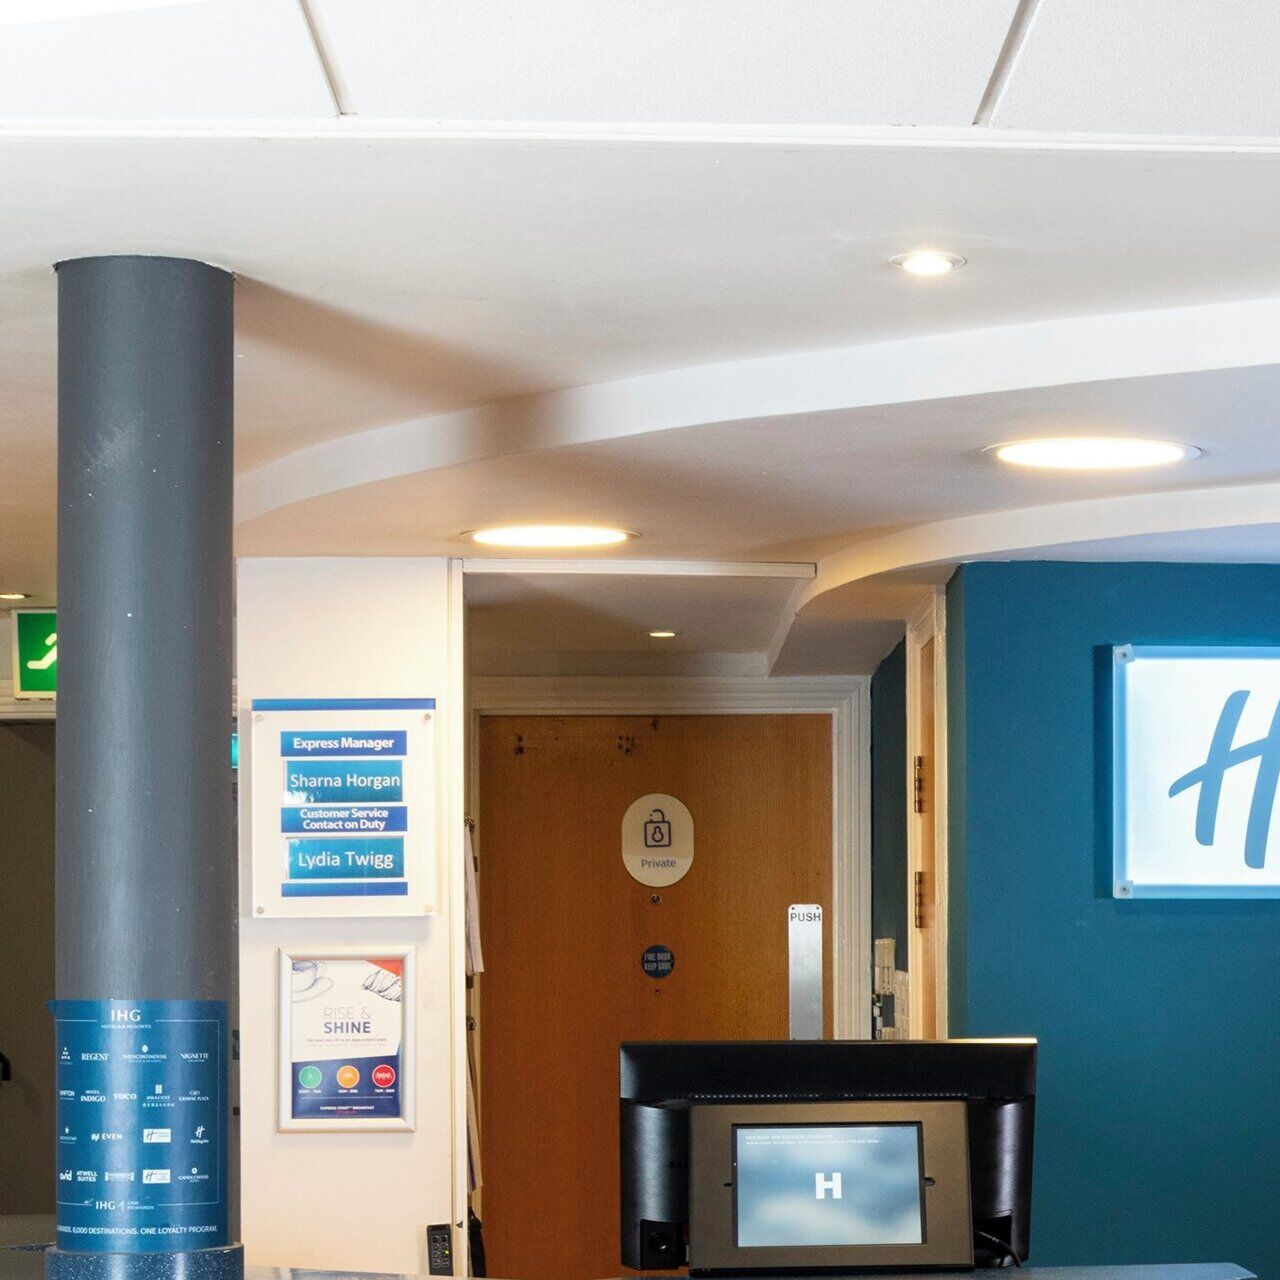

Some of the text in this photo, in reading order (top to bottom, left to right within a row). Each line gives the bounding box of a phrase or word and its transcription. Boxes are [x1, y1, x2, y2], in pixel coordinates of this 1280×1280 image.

[293, 738, 394, 750] Express Manager
[290, 774, 400, 789] Sharna Horgan
[300, 808, 388, 818] Customer Service
[303, 820, 343, 829] Contact
[360, 820, 386, 830] Duty
[298, 851, 394, 869] Lydia Twigg
[642, 858, 676, 868] Private
[790, 912, 821, 922] PUSH
[111, 1010, 140, 1022] IHG
[324, 1007, 371, 1020] RISE &
[324, 1022, 371, 1034] SHINE
[60, 1170, 72, 1180] avid
[96, 1201, 116, 1210] IHG
[89, 1226, 138, 1234] DESTINATIONS.
[158, 1227, 187, 1235] LOYALTY
[189, 1225, 217, 1233] PROGRAM.
